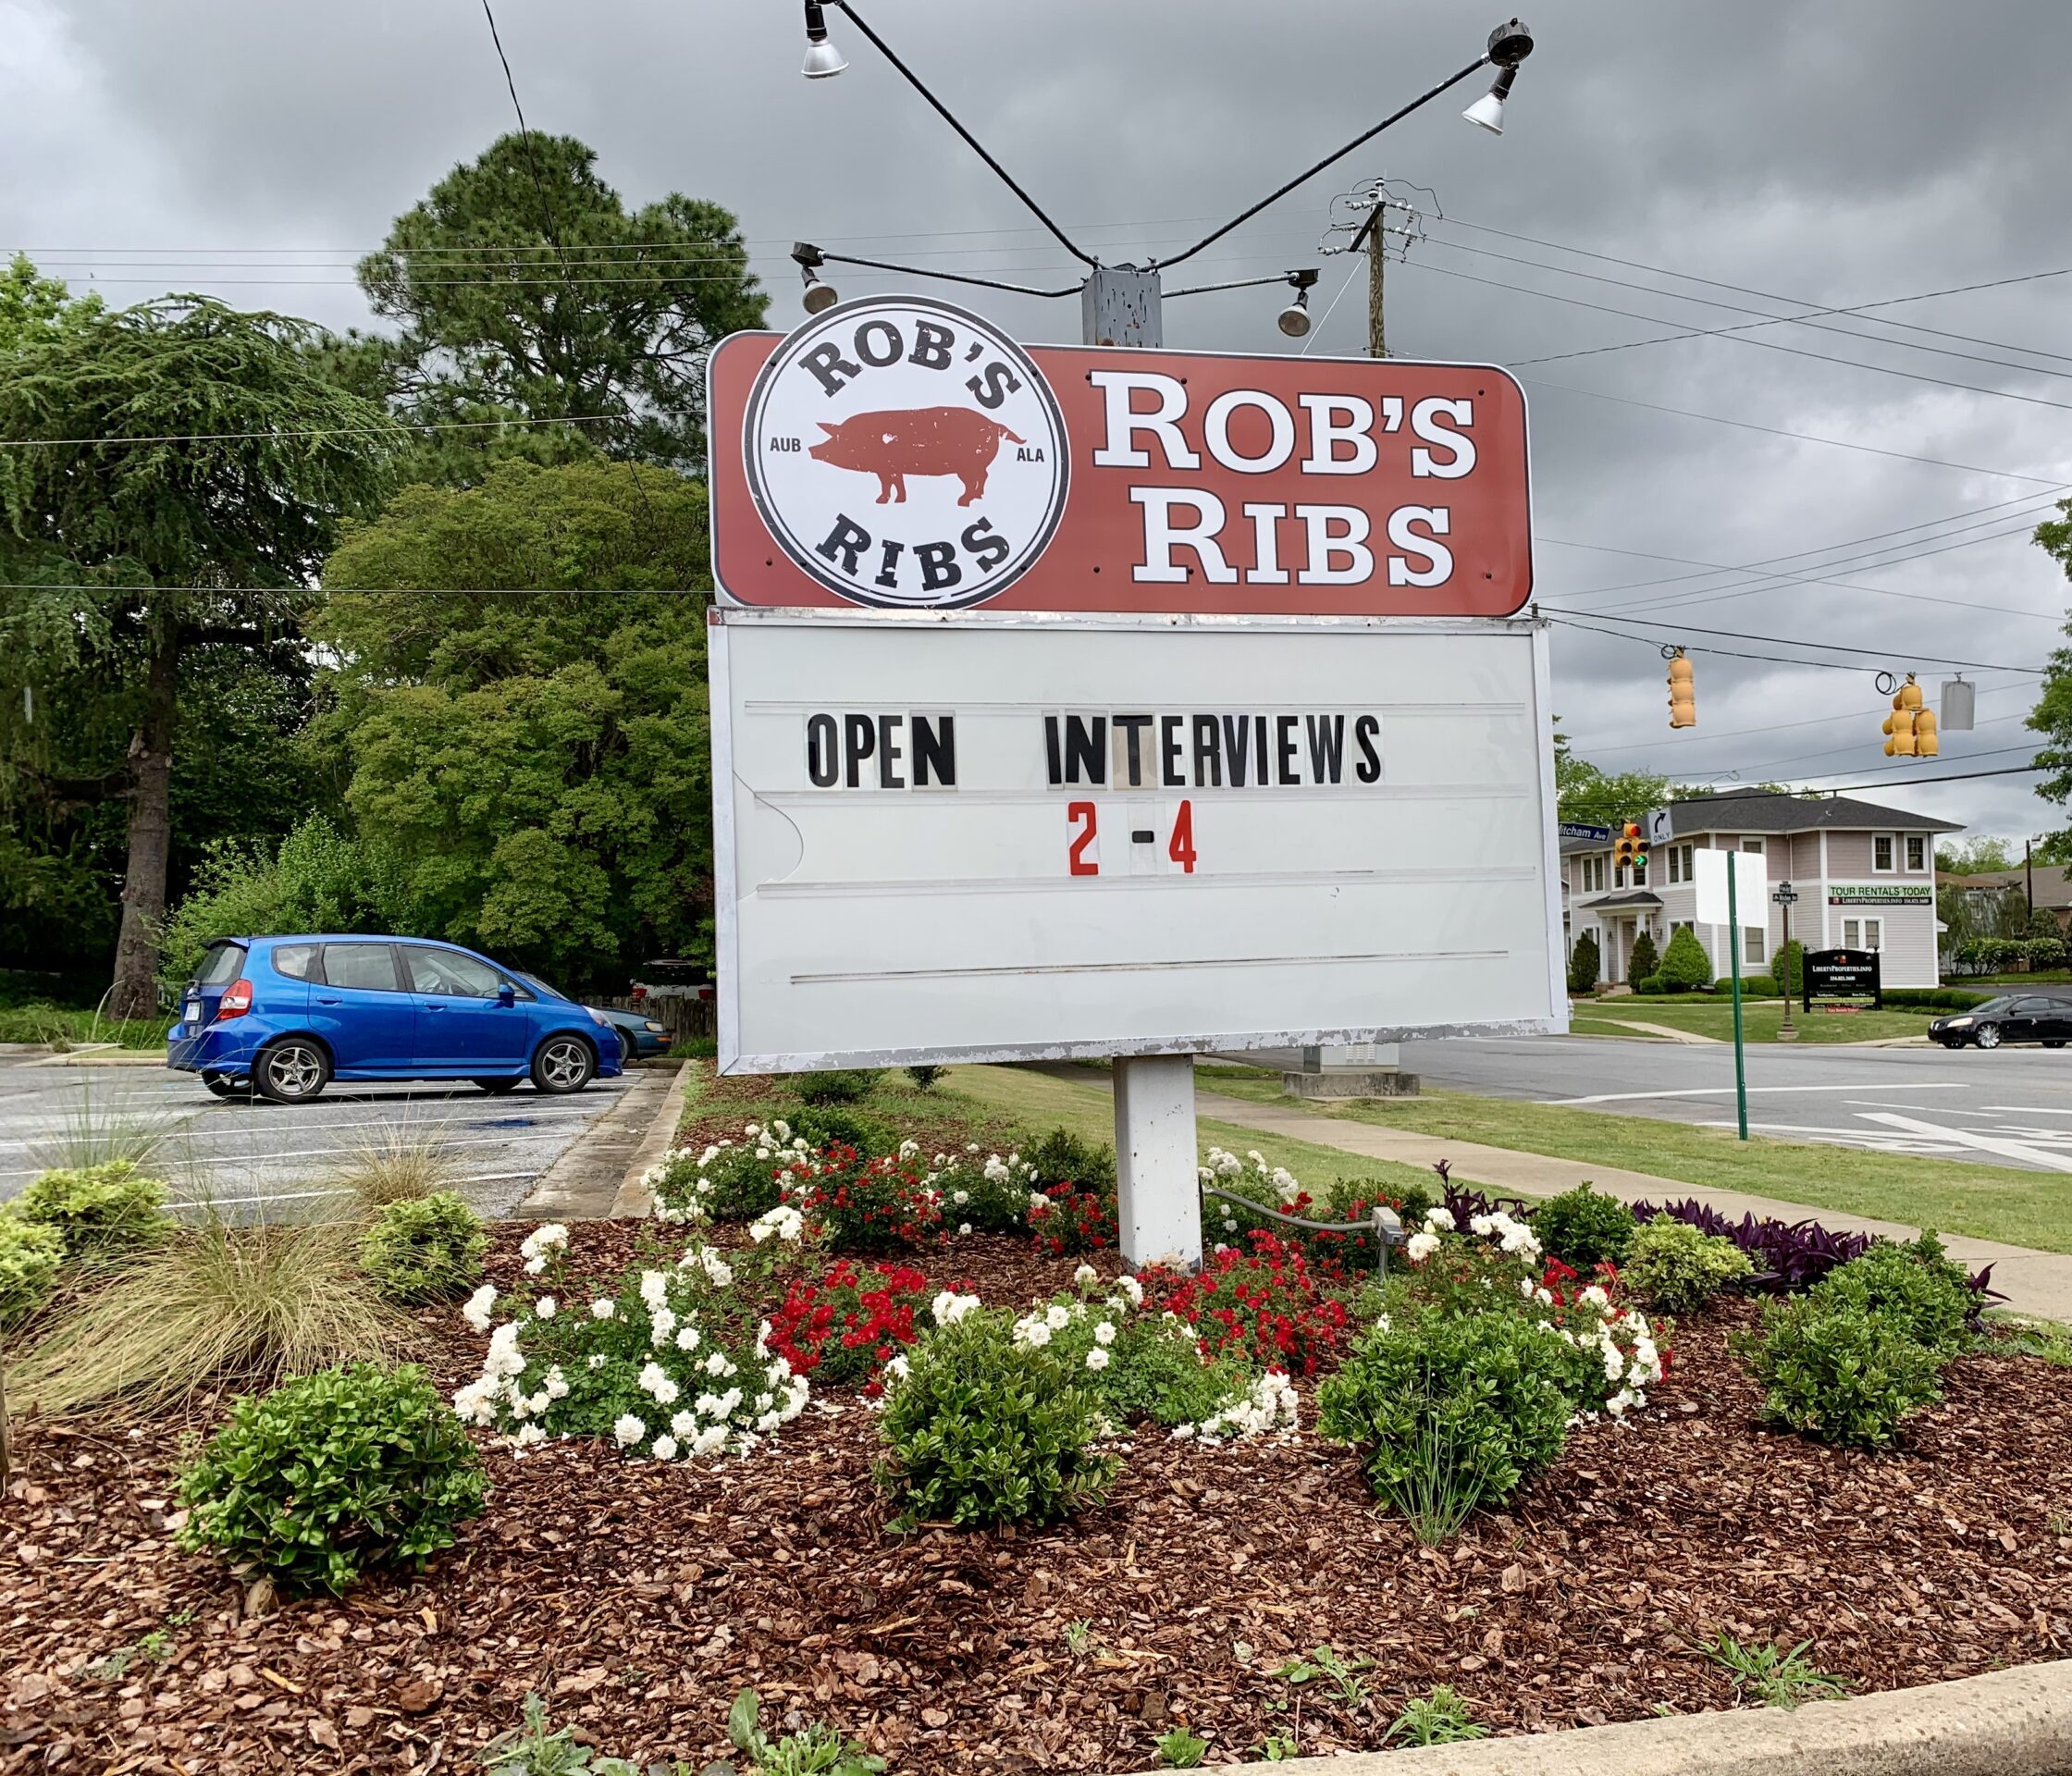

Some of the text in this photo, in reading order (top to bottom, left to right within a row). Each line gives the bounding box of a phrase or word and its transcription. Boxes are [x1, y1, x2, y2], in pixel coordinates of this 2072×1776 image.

[798, 319, 1022, 409] ROB'S
[770, 437, 801, 452] AUB
[1017, 448, 1044, 462] ALA
[1090, 370, 1478, 478] ROB'S
[815, 513, 1010, 591] RIBS
[1128, 486, 1455, 587] RIBS
[808, 713, 1381, 788] OPEN INTERVIEWS
[1068, 801, 1099, 876] 2
[1168, 799, 1197, 873] 4
[1594, 831, 1607, 840] Ave
[1653, 832, 1671, 843] ONLY
[1831, 887, 1931, 896] TOUR RENTALS TODAY
